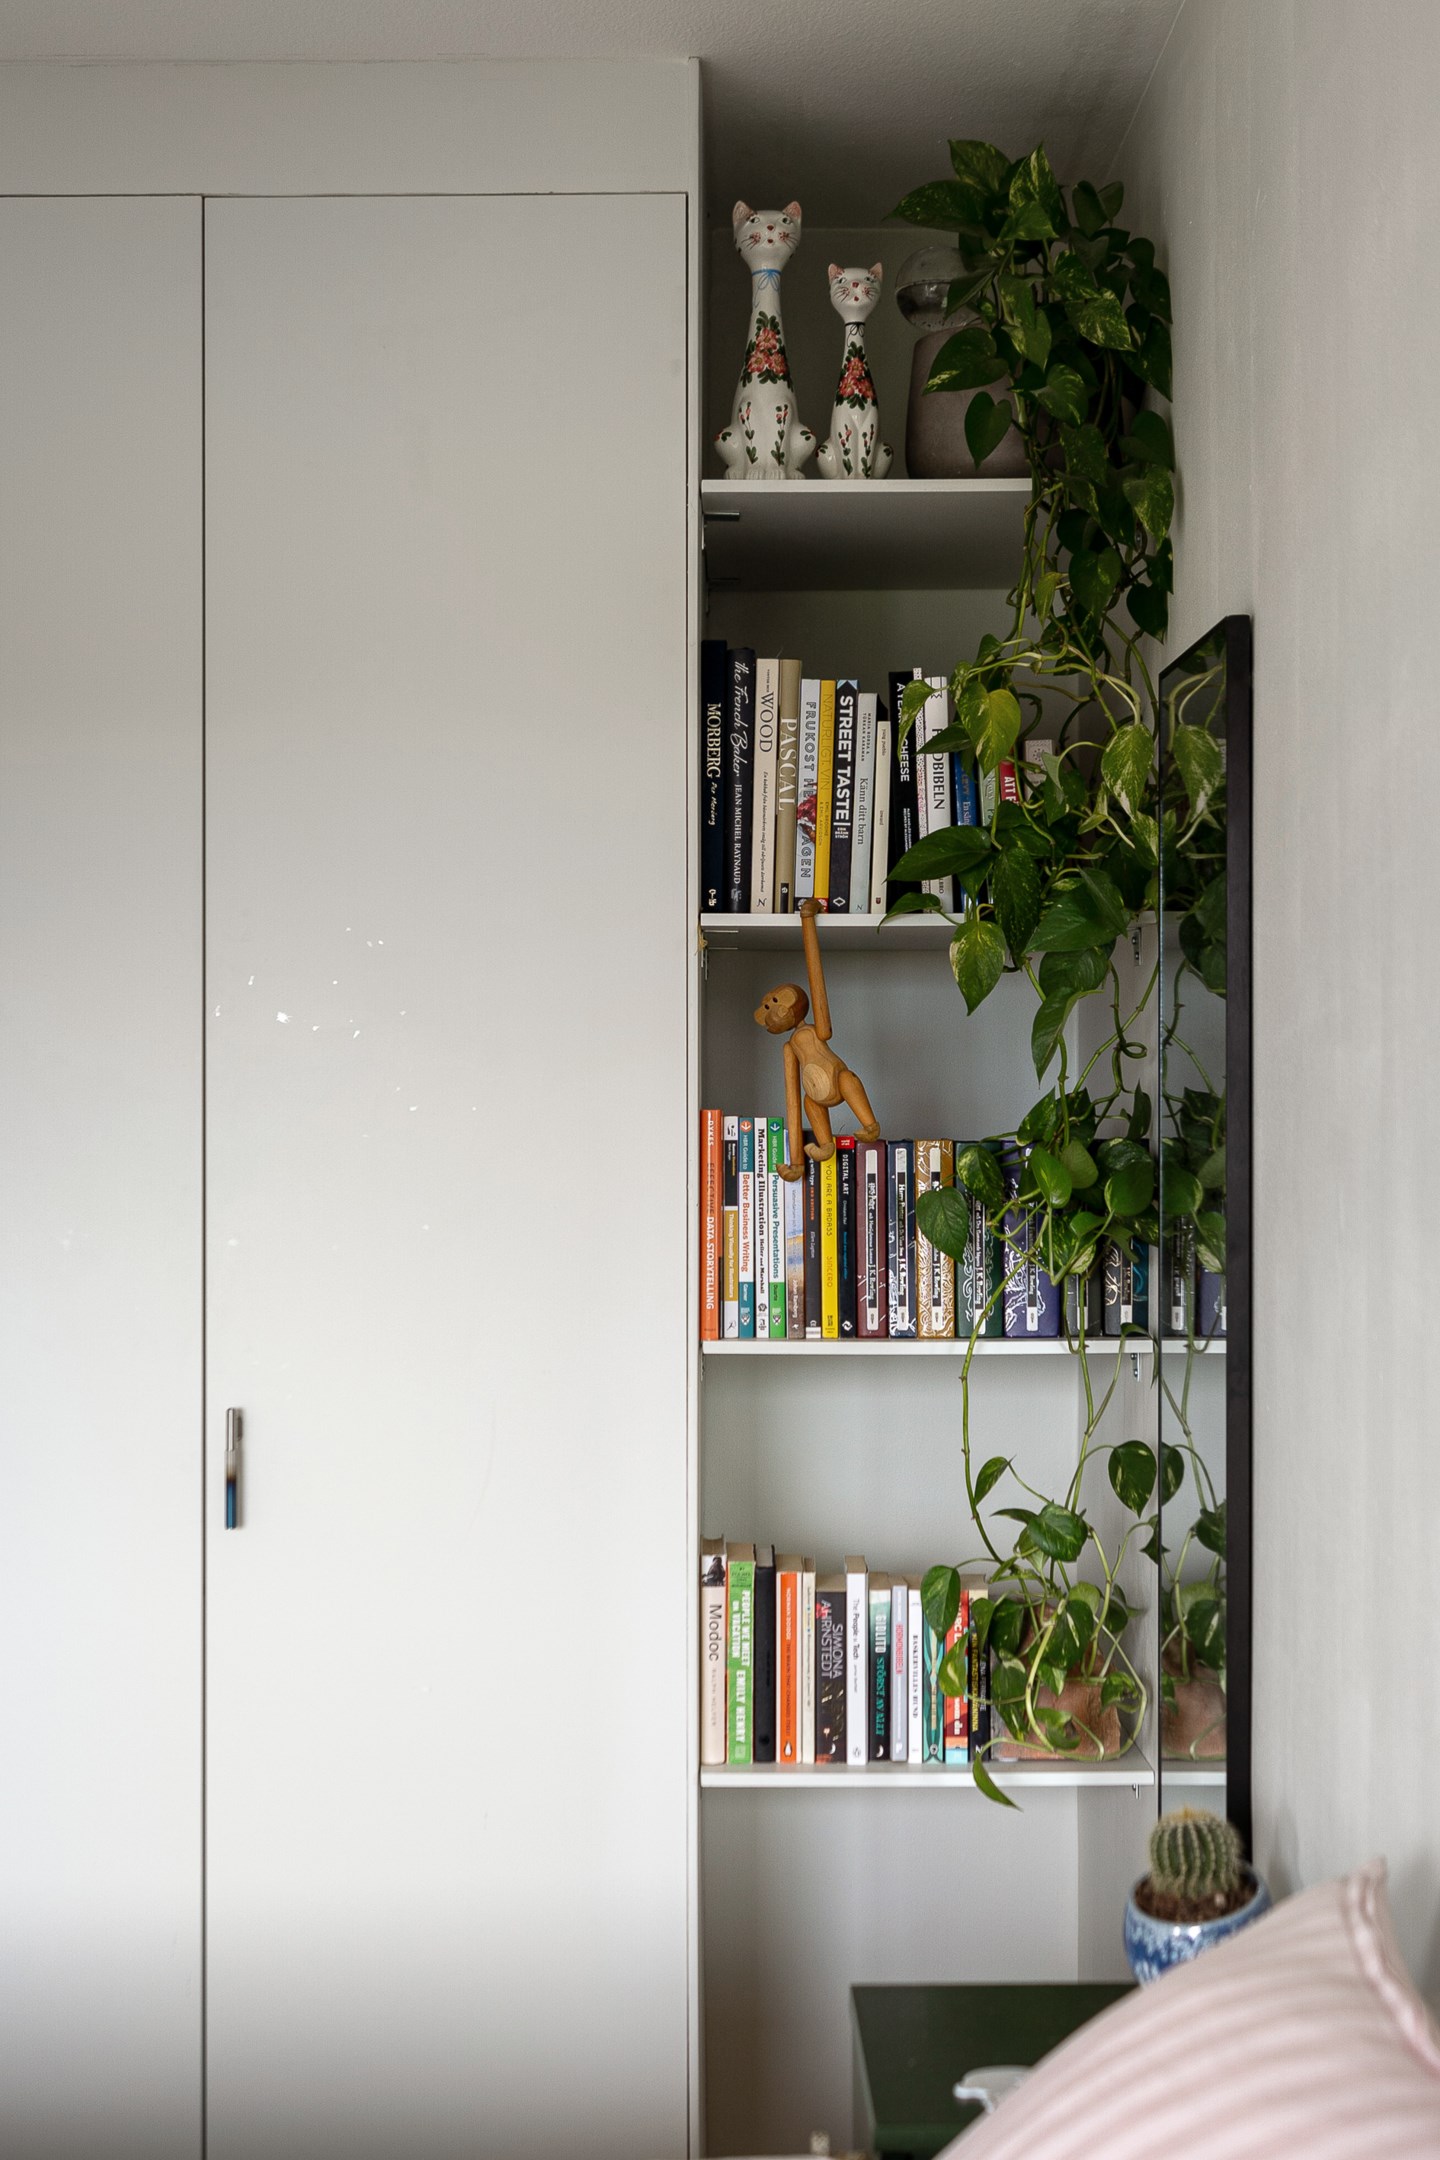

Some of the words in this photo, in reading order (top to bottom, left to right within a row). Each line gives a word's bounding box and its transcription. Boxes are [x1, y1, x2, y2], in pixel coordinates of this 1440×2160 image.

[734, 686, 748, 729] French
[759, 692, 774, 753] WOOD
[707, 703, 721, 778] MORBERG
[804, 702, 817, 772] FRUKOST
[840, 696, 853, 762] STREET
[730, 731, 748, 776] Baker
[778, 718, 798, 811] PASCAL
[735, 784, 743, 805] JEAN
[820, 770, 831, 790] VIN
[836, 766, 852, 820] TASTE
[858, 778, 868, 803] Känn
[1004, 776, 1016, 793] ATT
[734, 808, 742, 841] MICHEL
[858, 805, 867, 822] ditt
[858, 824, 867, 845] barn
[734, 843, 742, 884] RAYNAUD
[758, 1128, 766, 1178] Marketing
[742, 1203, 750, 1240] Business
[758, 1180, 766, 1235] Illustration
[706, 1216, 715, 1240] DATA
[772, 1221, 780, 1279] Presentations
[706, 1242, 715, 1309] STORYTELLING
[826, 1256, 834, 1287] SINCERO
[898, 1272, 906, 1296] Rowling
[932, 1278, 940, 1299] Rowling
[1028, 1275, 1036, 1295] Rowling
[742, 1590, 751, 1624] PEOPLE
[852, 1613, 860, 1636] People
[708, 1604, 722, 1662] Modoc
[732, 1613, 741, 1659] VACATION
[742, 1626, 751, 1640] WE
[821, 1600, 833, 1679] AHRNSTEDT
[832, 1624, 844, 1679] SIMONA
[874, 1615, 887, 1653] GIOLITO
[742, 1642, 750, 1667] MEET
[852, 1644, 860, 1660] Tech
[736, 1670, 746, 1703] EMILY
[876, 1656, 887, 1697] STÖRST
[876, 1698, 885, 1710] AV
[736, 1706, 746, 1743] HENRY
[876, 1712, 885, 1737] ALLT
